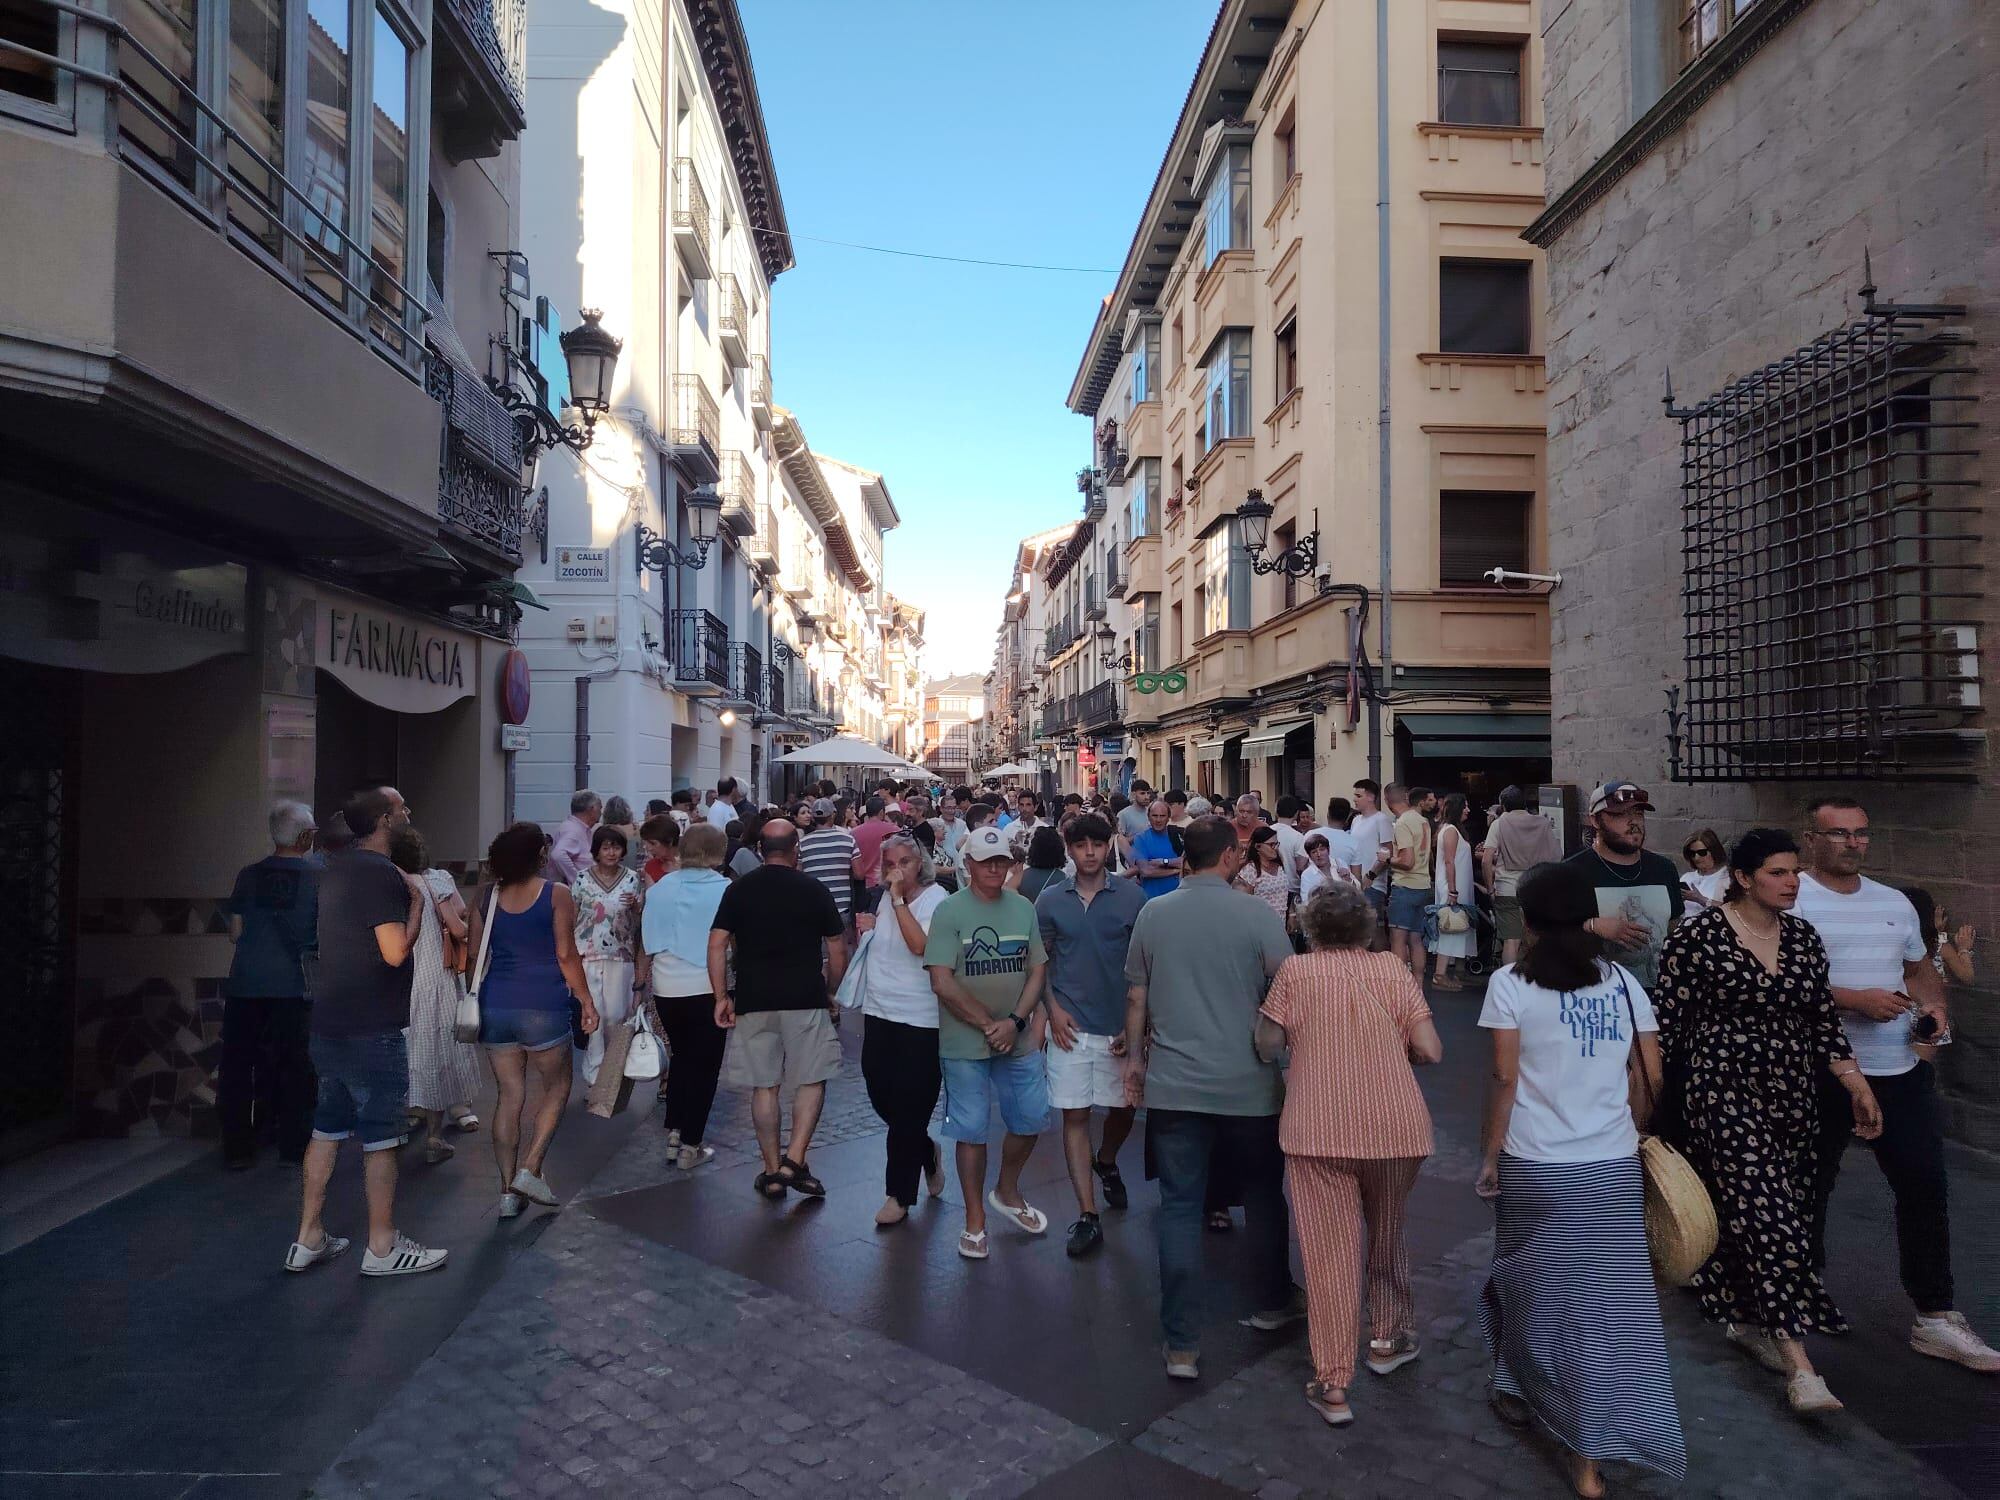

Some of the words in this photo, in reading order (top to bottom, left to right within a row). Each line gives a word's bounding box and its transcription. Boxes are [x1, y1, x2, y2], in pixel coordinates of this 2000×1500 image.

[577, 553, 603, 561] CALLE
[562, 565, 603, 577] ZOCOTÍN
[330, 608, 464, 688] FARMACIA
[965, 956, 1025, 977] MARMO
[1560, 991, 1619, 1014] Don't
[1571, 1016, 1626, 1042] think
[1581, 1040, 1597, 1057] it
